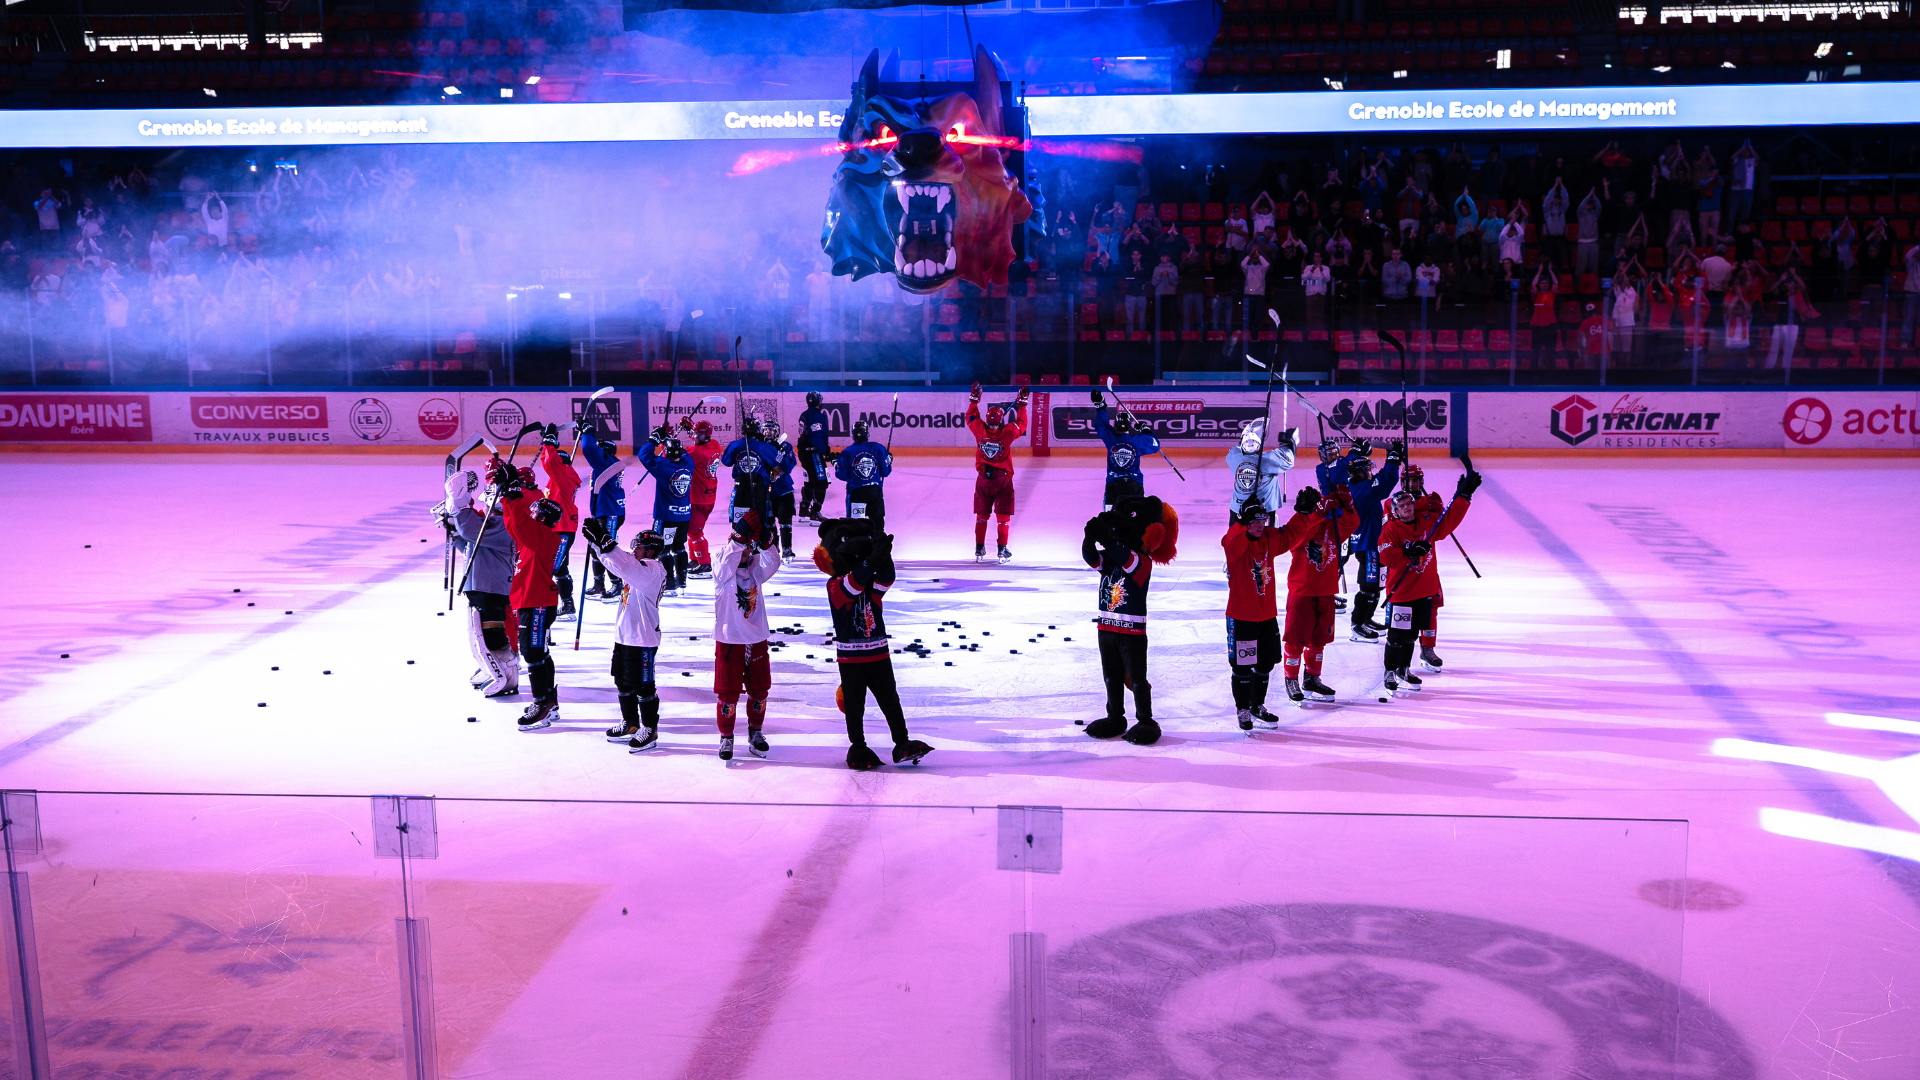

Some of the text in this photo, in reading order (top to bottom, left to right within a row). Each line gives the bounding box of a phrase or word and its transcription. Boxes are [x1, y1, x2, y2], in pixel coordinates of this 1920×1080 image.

[1348, 98, 1677, 120] Grenoble Ecole de Management
[138, 116, 428, 137] Grenoble Ecole de Management
[725, 111, 845, 128] Grenoble Ec
[198, 405, 320, 420] CONVERSO
[709, 405, 727, 415] PRO
[1118, 403, 1202, 411] HOCKEY SUR GLACE
[1610, 393, 1645, 419] Gilles
[0, 402, 144, 428] DAUPHINÉ
[489, 415, 522, 425] DETECTE
[859, 412, 966, 428] McDonald
[1035, 394, 1045, 446] Eden Park
[1327, 398, 1448, 431] SAMSE
[1602, 407, 1721, 431] TRIGNAT
[194, 432, 330, 442] TRAVAUX PUBLICS
[1386, 436, 1448, 444] CONTRUCTION
[1605, 437, 1717, 447] RESIDENCES
[1101, 618, 1134, 629] randstad
[486, 653, 503, 678] CCM
